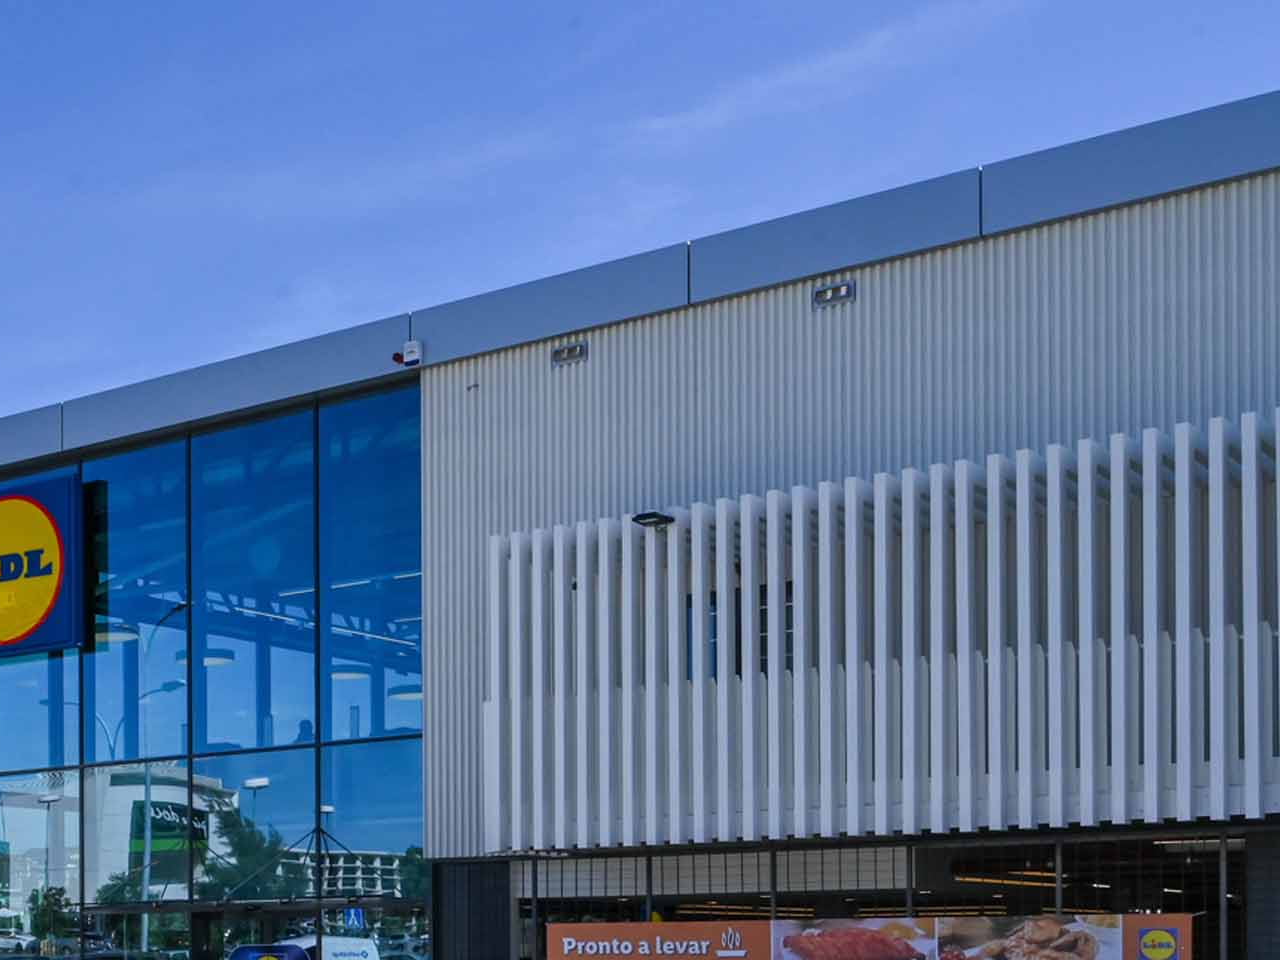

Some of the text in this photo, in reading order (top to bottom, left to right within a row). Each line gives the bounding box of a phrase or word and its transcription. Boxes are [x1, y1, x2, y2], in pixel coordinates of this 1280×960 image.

[562, 936, 710, 955] Pronto a levar
